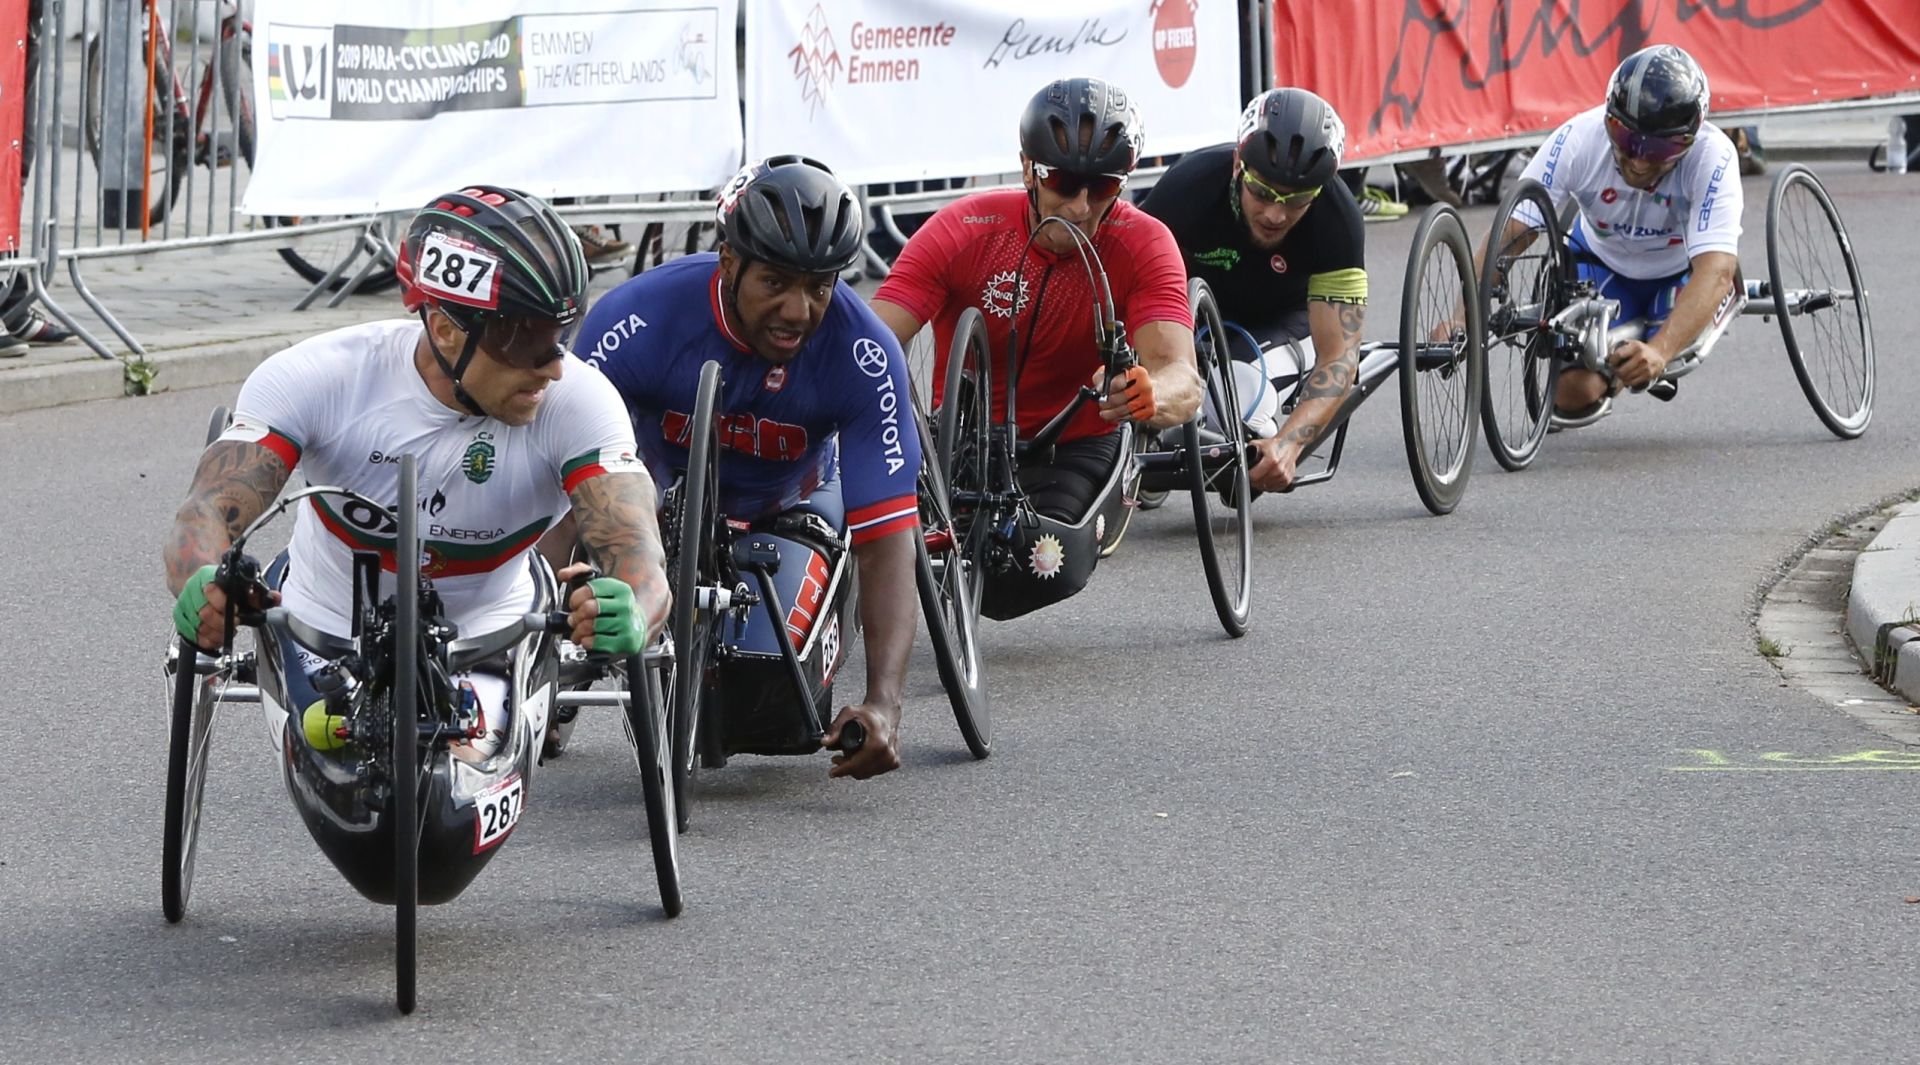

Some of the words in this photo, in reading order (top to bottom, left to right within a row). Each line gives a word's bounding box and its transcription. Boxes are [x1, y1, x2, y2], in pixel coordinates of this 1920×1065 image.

[531, 31, 594, 56] EMMEN
[850, 20, 957, 51] Gemeente
[337, 43, 361, 69] 2019
[362, 40, 481, 71] PARA-CYCLING
[847, 54, 920, 84] Emmen
[336, 76, 383, 104] WORLD
[384, 66, 508, 104] CHAMPIONSHIPS
[534, 65, 562, 89] THE
[561, 58, 667, 88] NETHERLANDS
[423, 246, 493, 294] 287
[876, 373, 906, 477] TOYOTA
[429, 524, 506, 541] ENERGIA
[483, 786, 521, 839] 287
